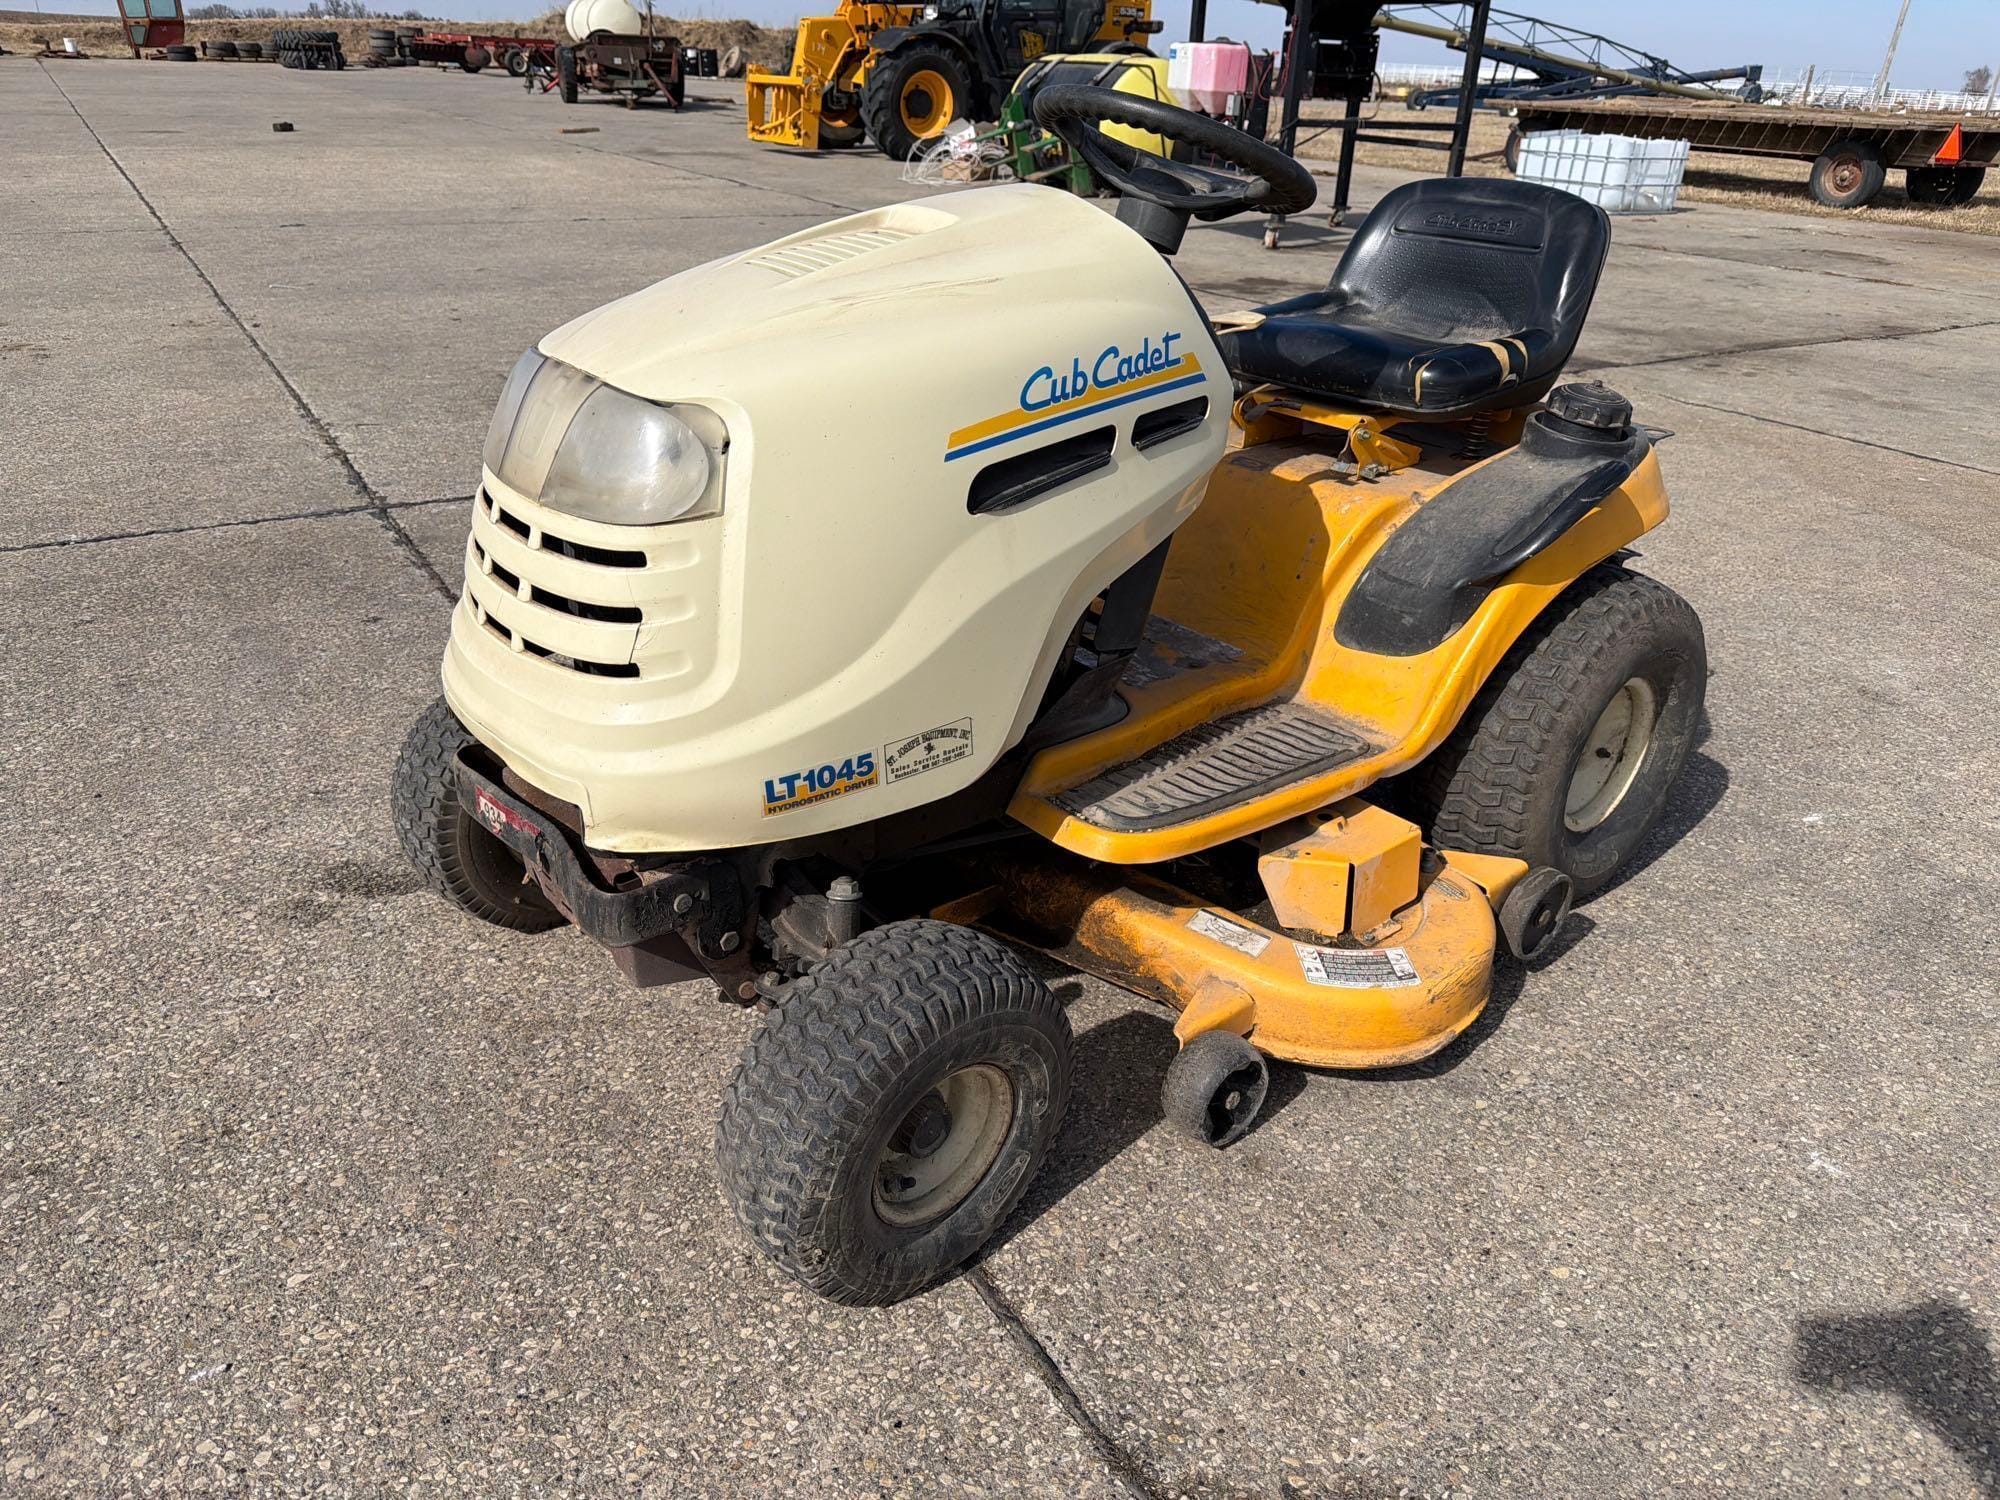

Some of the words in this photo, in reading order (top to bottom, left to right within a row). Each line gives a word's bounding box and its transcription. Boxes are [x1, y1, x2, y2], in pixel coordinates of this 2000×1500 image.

[1020, 357, 1088, 412] Cub
[1092, 331, 1182, 389] Cadet
[890, 763, 910, 775] Sales
[913, 753, 940, 767] Service
[943, 743, 969, 756] Rentals
[897, 736, 921, 758] JOSEPH
[764, 752, 875, 804] LT1045
[767, 788, 842, 815] HYDROSTATIC
[843, 777, 875, 793] DRIVE
